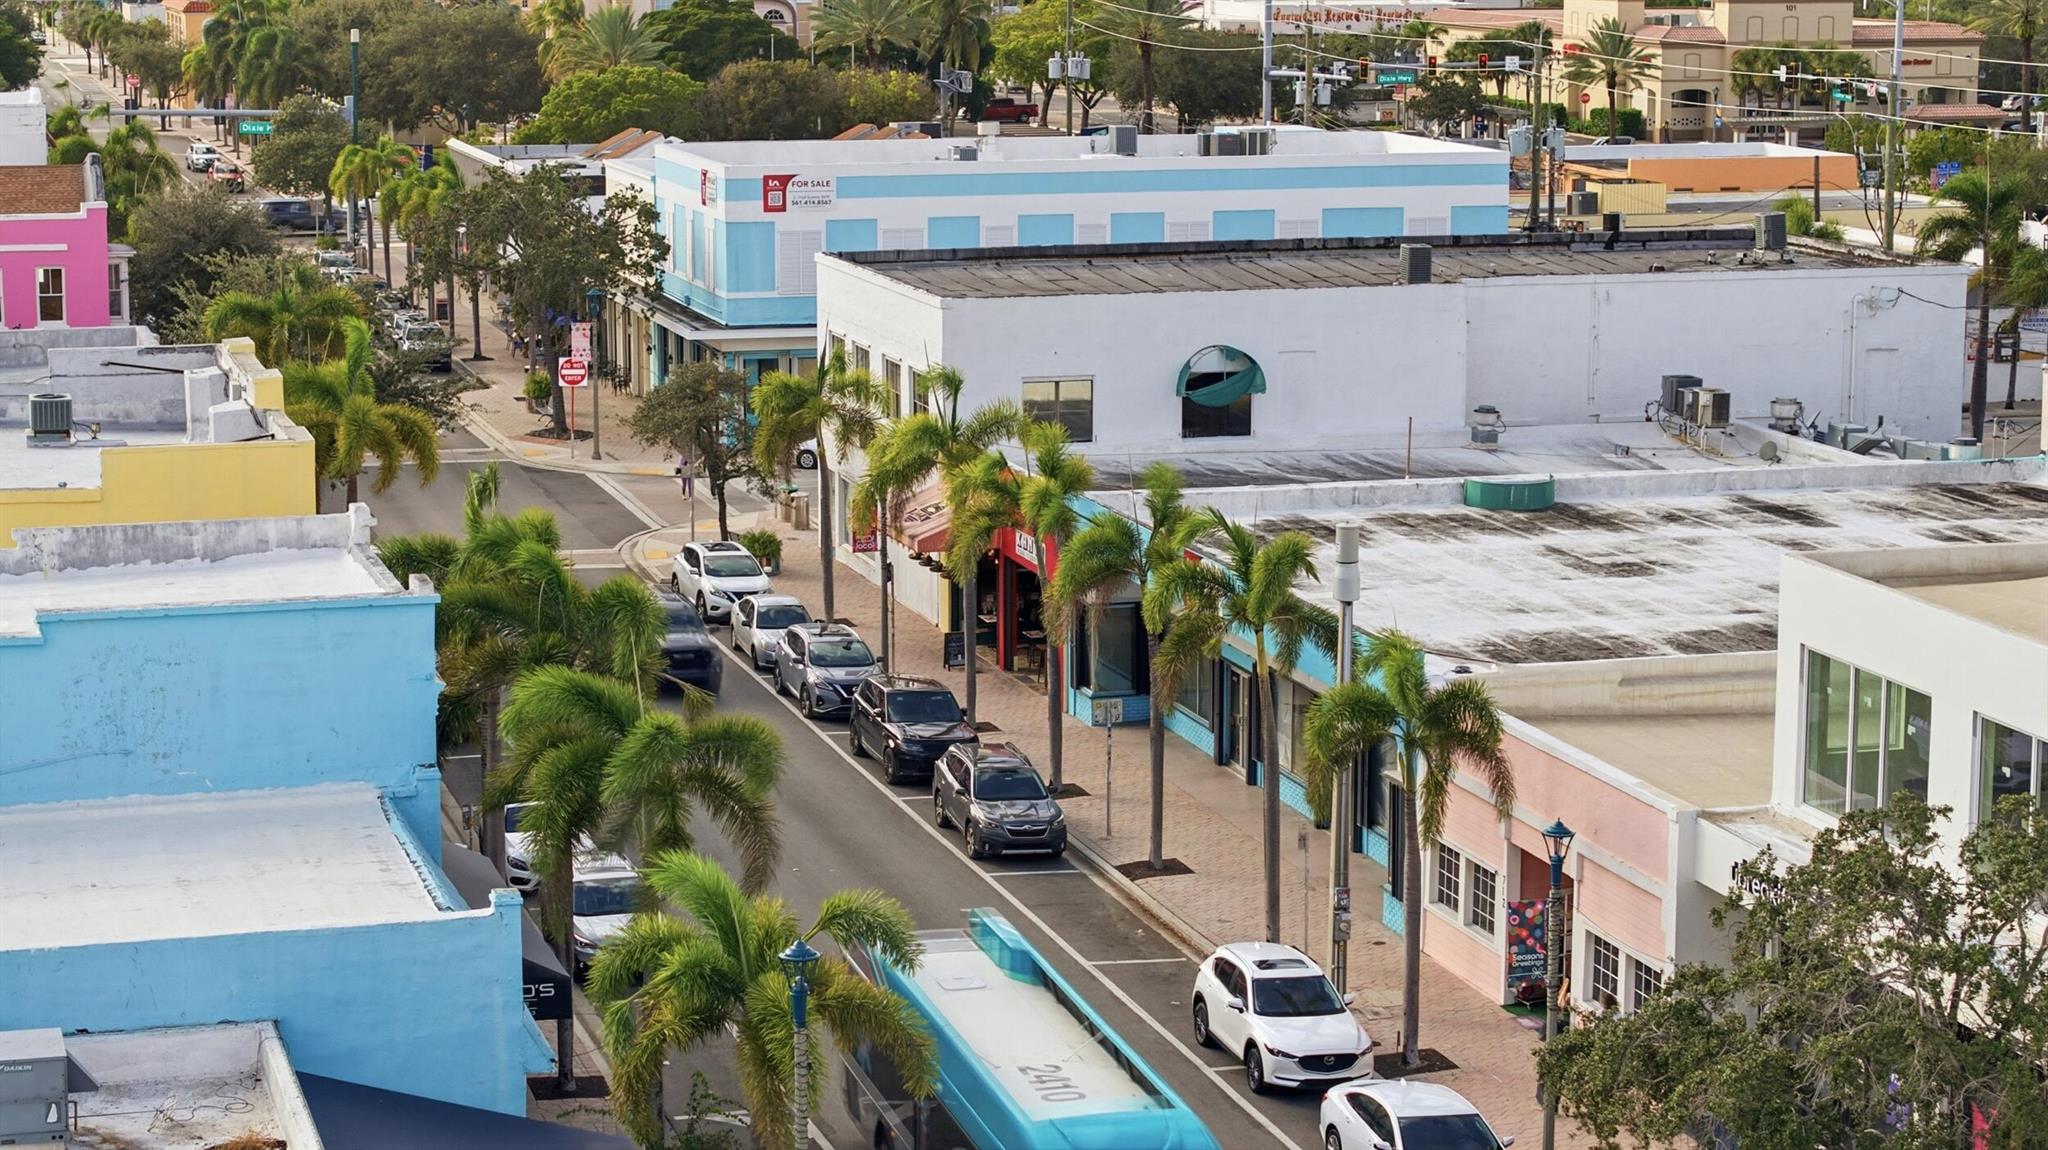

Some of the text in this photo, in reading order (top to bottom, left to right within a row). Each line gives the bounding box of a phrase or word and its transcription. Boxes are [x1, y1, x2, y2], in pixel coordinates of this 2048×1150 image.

[1398, 75, 1412, 83] Hwy
[791, 180, 809, 188] FOR
[1511, 953, 1544, 961] Seasons
[1016, 1064, 1086, 1102] 2410
